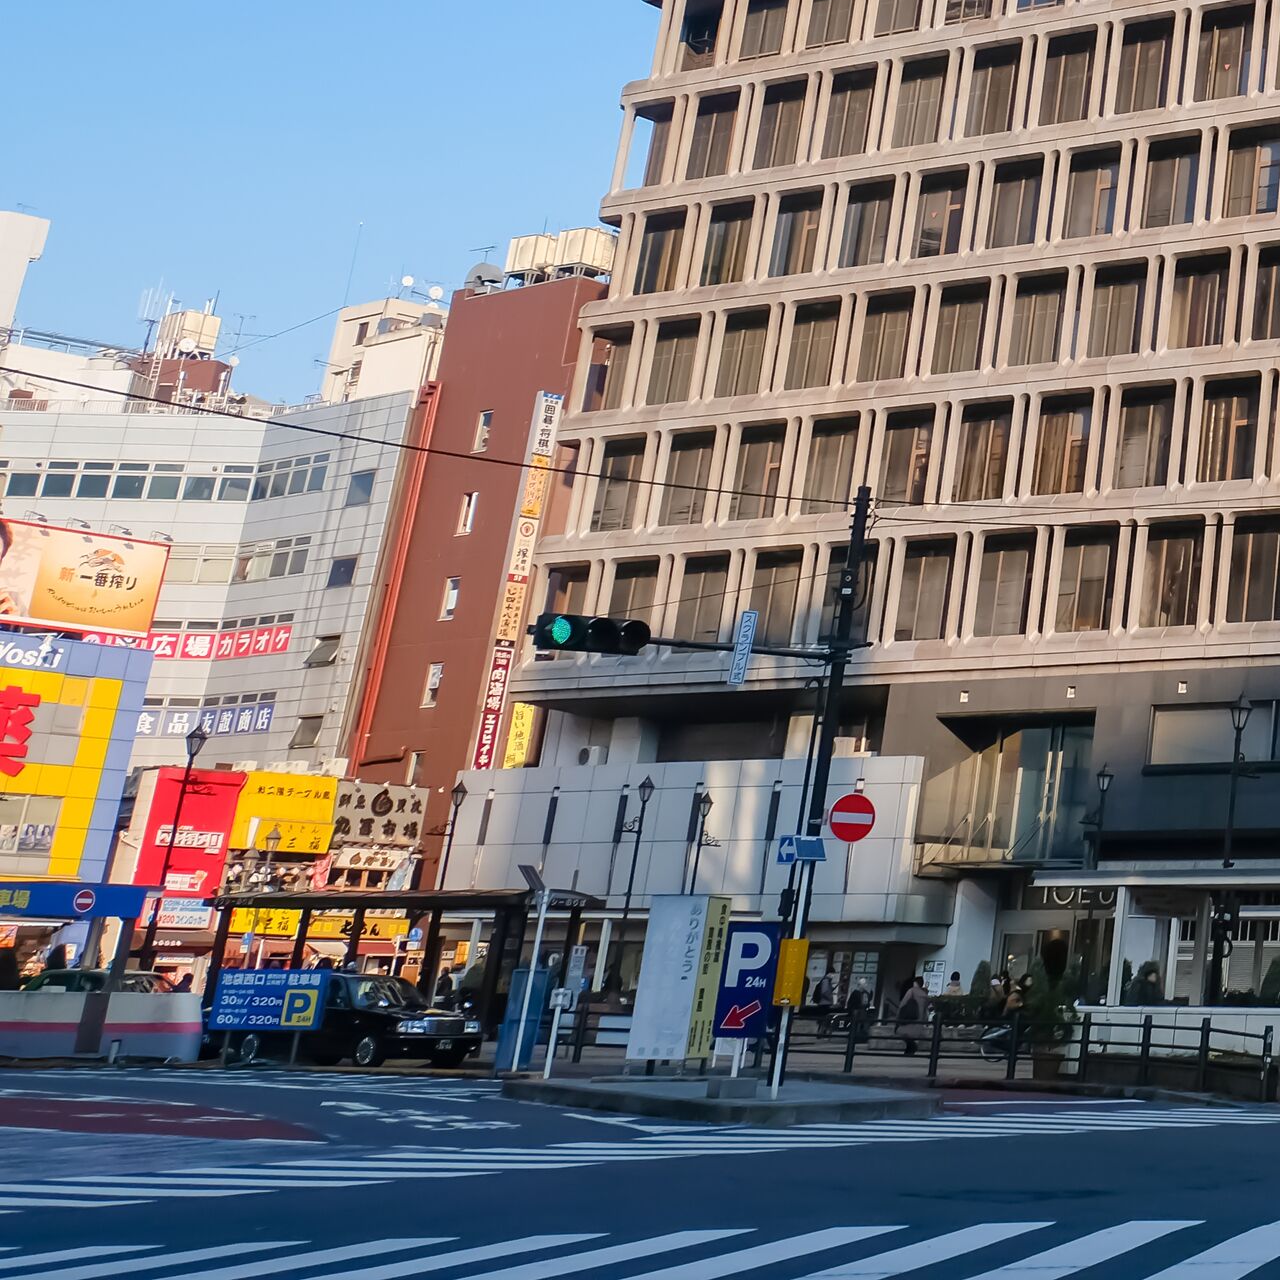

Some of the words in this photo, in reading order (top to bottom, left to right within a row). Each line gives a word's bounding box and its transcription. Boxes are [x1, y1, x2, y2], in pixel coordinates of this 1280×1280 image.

[217, 630, 292, 656] カラオケ
[724, 931, 772, 988] P
[744, 976, 767, 989] 24H
[284, 992, 312, 1023] P
